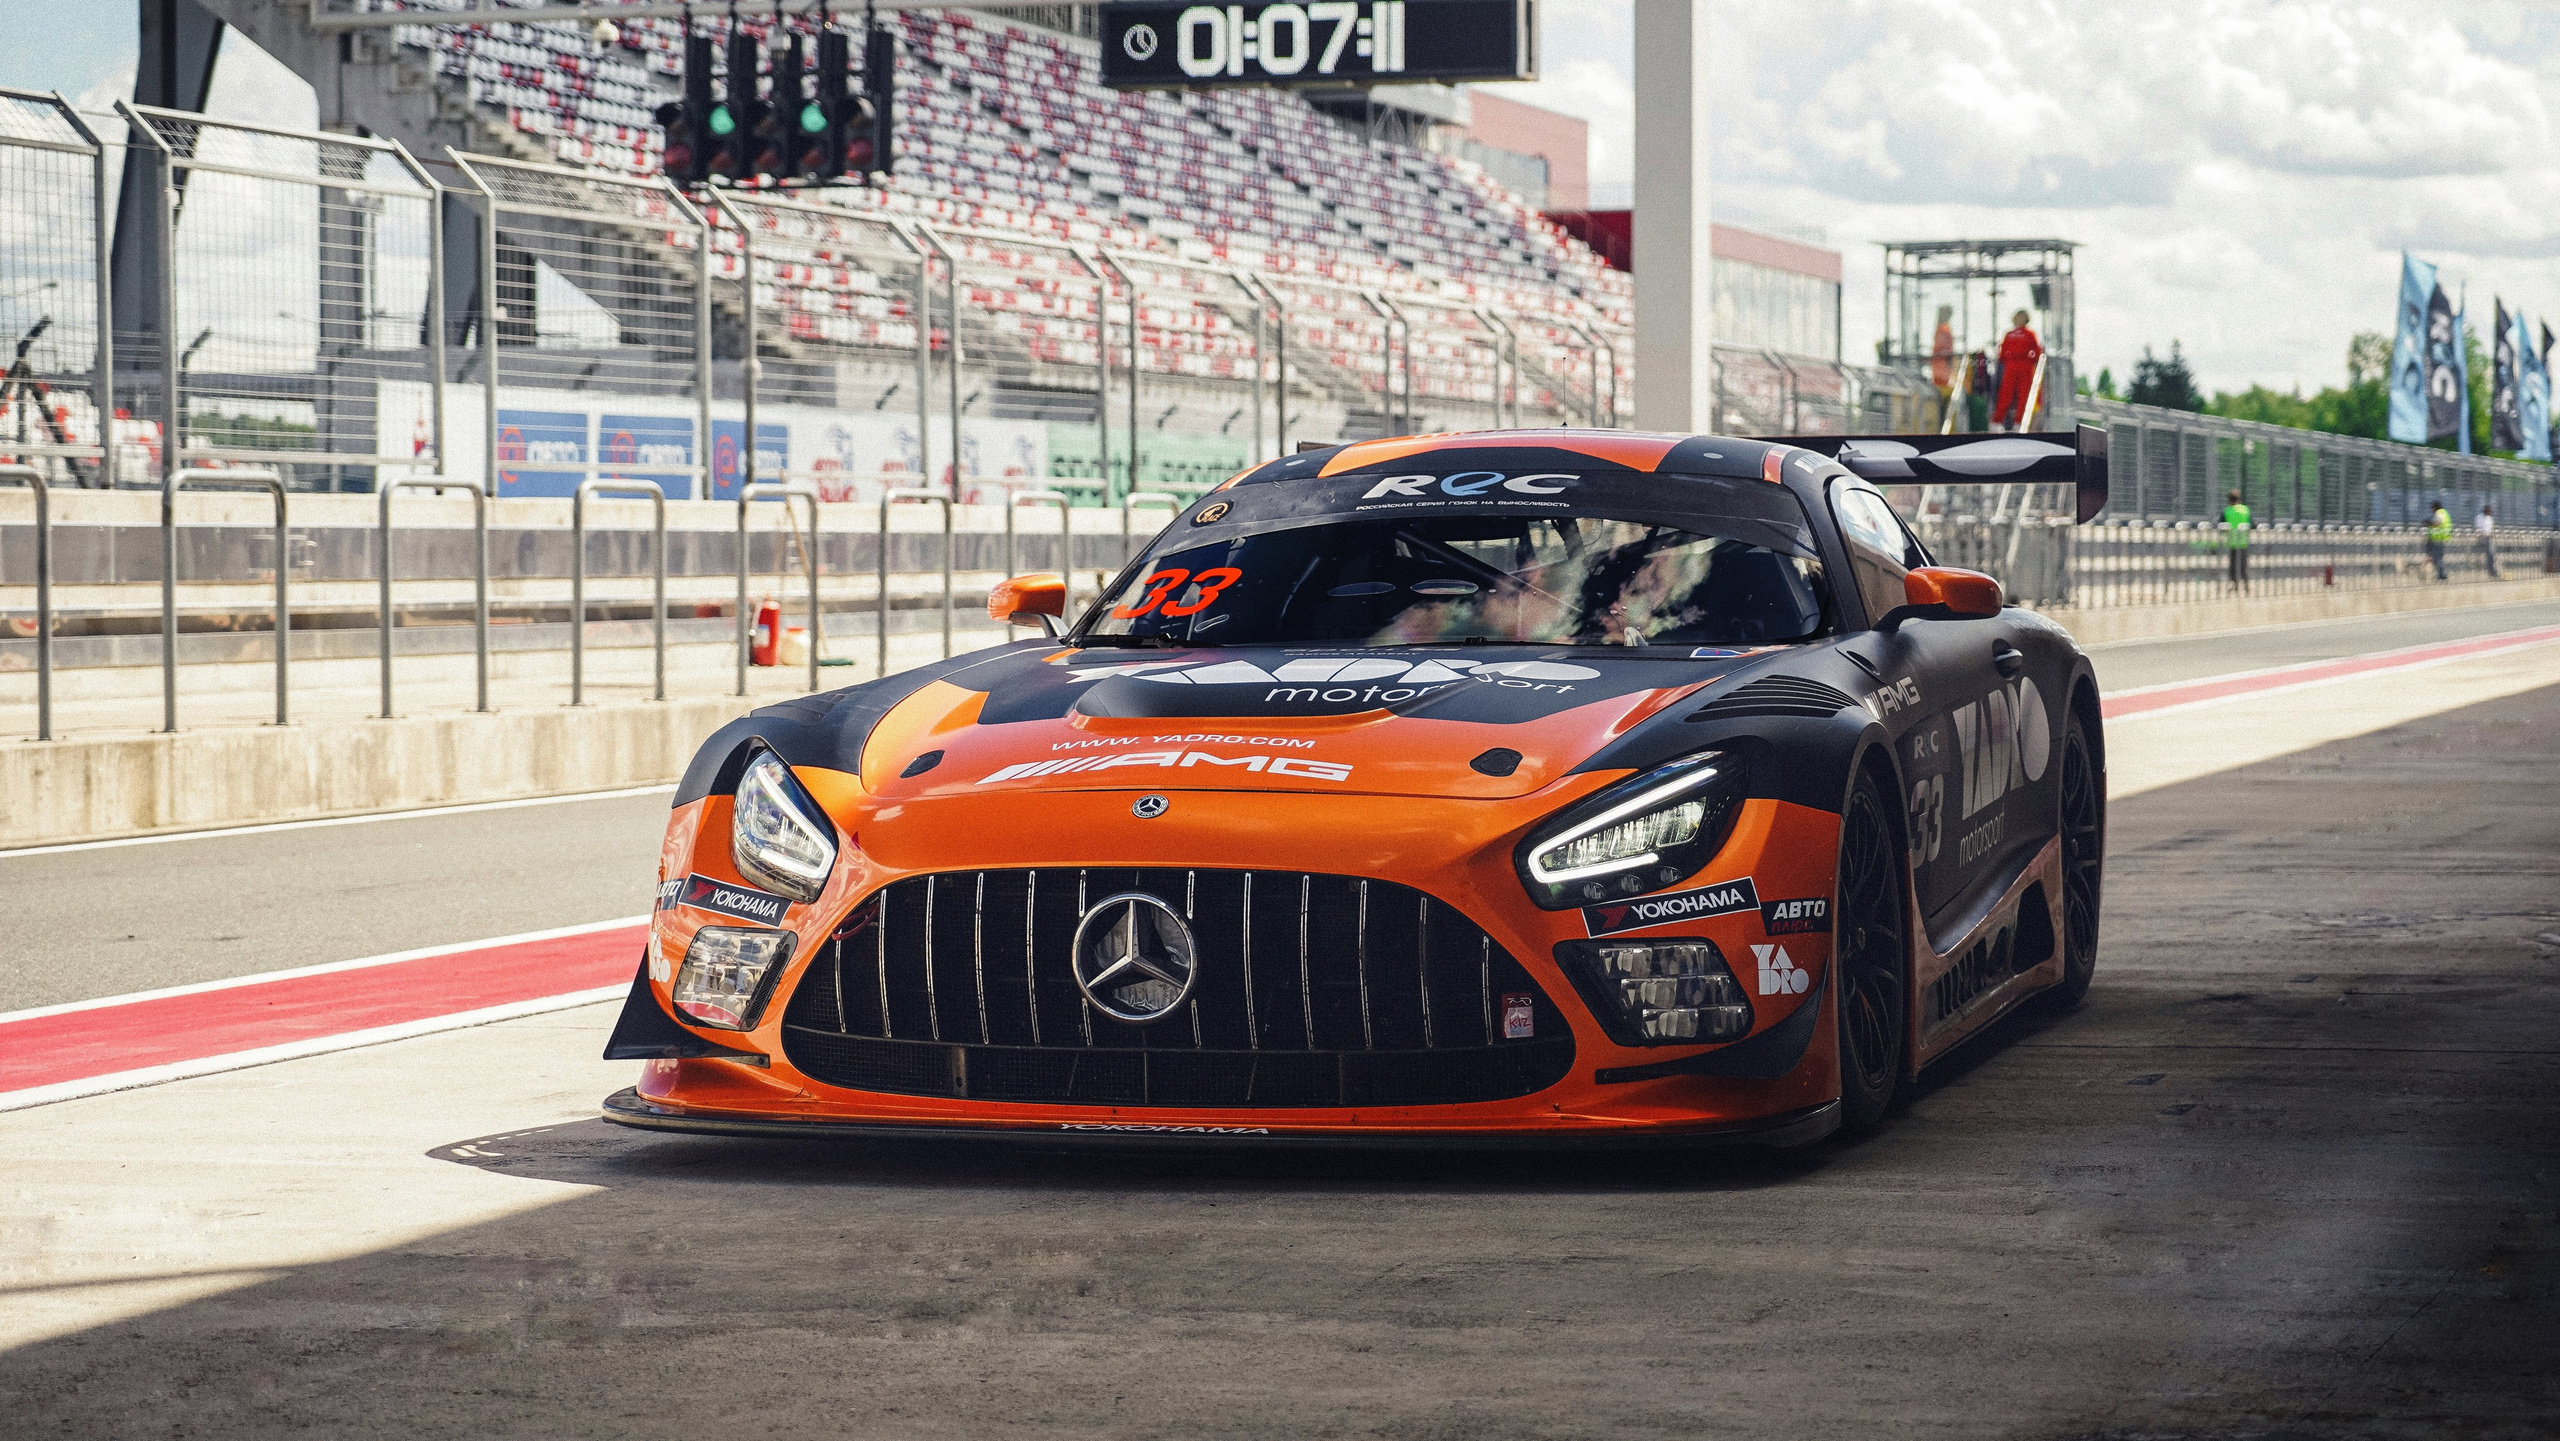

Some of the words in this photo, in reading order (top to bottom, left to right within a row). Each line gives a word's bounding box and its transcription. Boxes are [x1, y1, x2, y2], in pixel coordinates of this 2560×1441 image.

[1176, 1, 1406, 77] 01:07:11
[1355, 502, 1413, 511] РОССИЙСКАЯ
[1497, 500, 1570, 508] ВЫНОСЛИВОСТЬ
[1111, 567, 1243, 620] 33
[1877, 676, 1921, 716] AMG
[1153, 734, 1317, 750] YADRO.COM
[1952, 676, 2051, 821] YADRO
[1089, 750, 1354, 782] AMG
[1910, 774, 1944, 870] 33
[1959, 802, 2005, 868] motorsport
[710, 887, 779, 919] YOKOHAMA
[1631, 887, 1746, 921] YOKOHAMA
[1773, 900, 1826, 920] АВТО
[1060, 1122, 1270, 1134] YOKOHAMA
